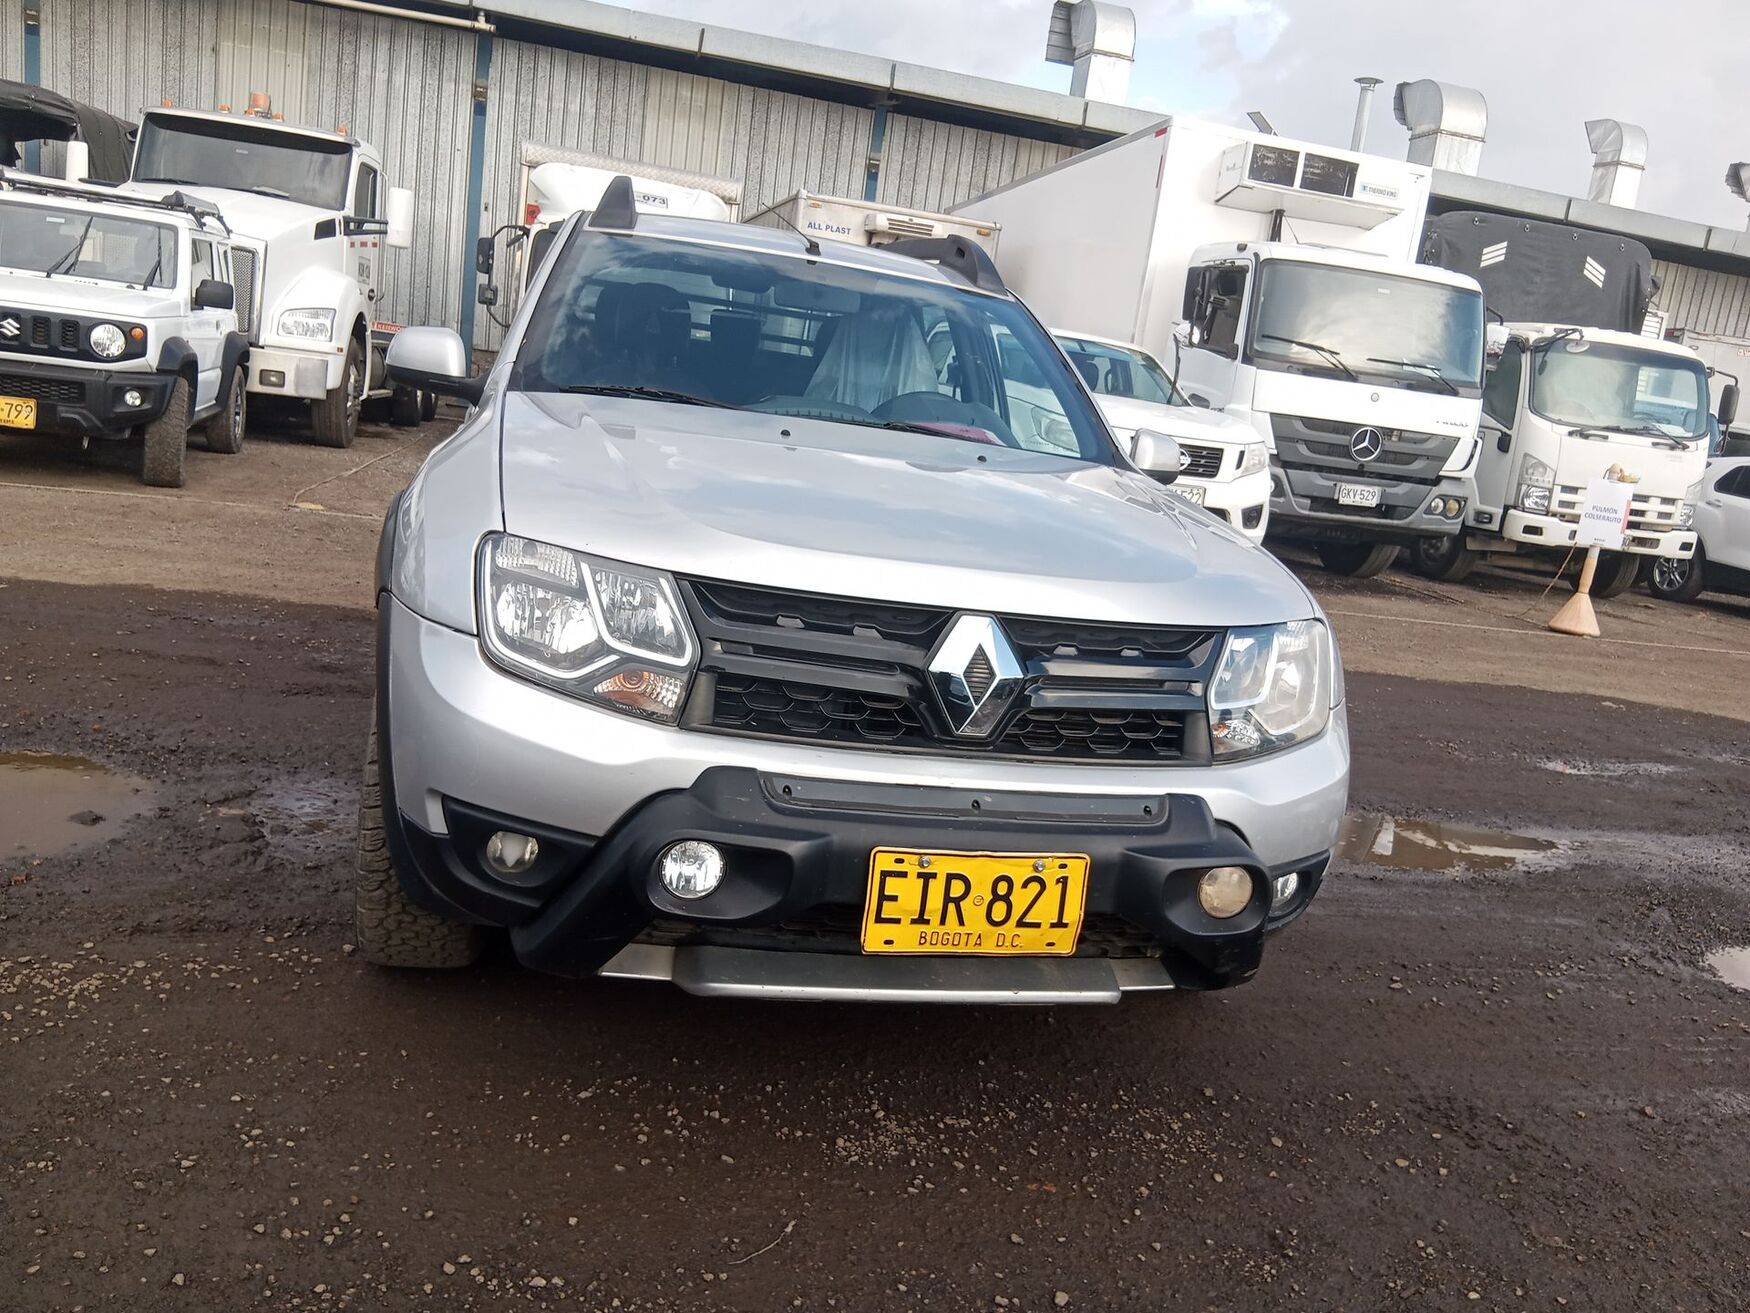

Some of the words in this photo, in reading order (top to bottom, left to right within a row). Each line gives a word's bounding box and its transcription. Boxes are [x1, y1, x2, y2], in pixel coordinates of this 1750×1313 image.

[807, 221, 823, 231] ALL
[825, 224, 851, 236] PLAST
[1592, 504, 1619, 515] PULMÓN
[1584, 511, 1622, 524] COLSERAUTO
[874, 870, 972, 927] EIR
[985, 874, 1070, 929] 821
[918, 930, 984, 948] BOGOTA
[995, 932, 1024, 949] D.C.
